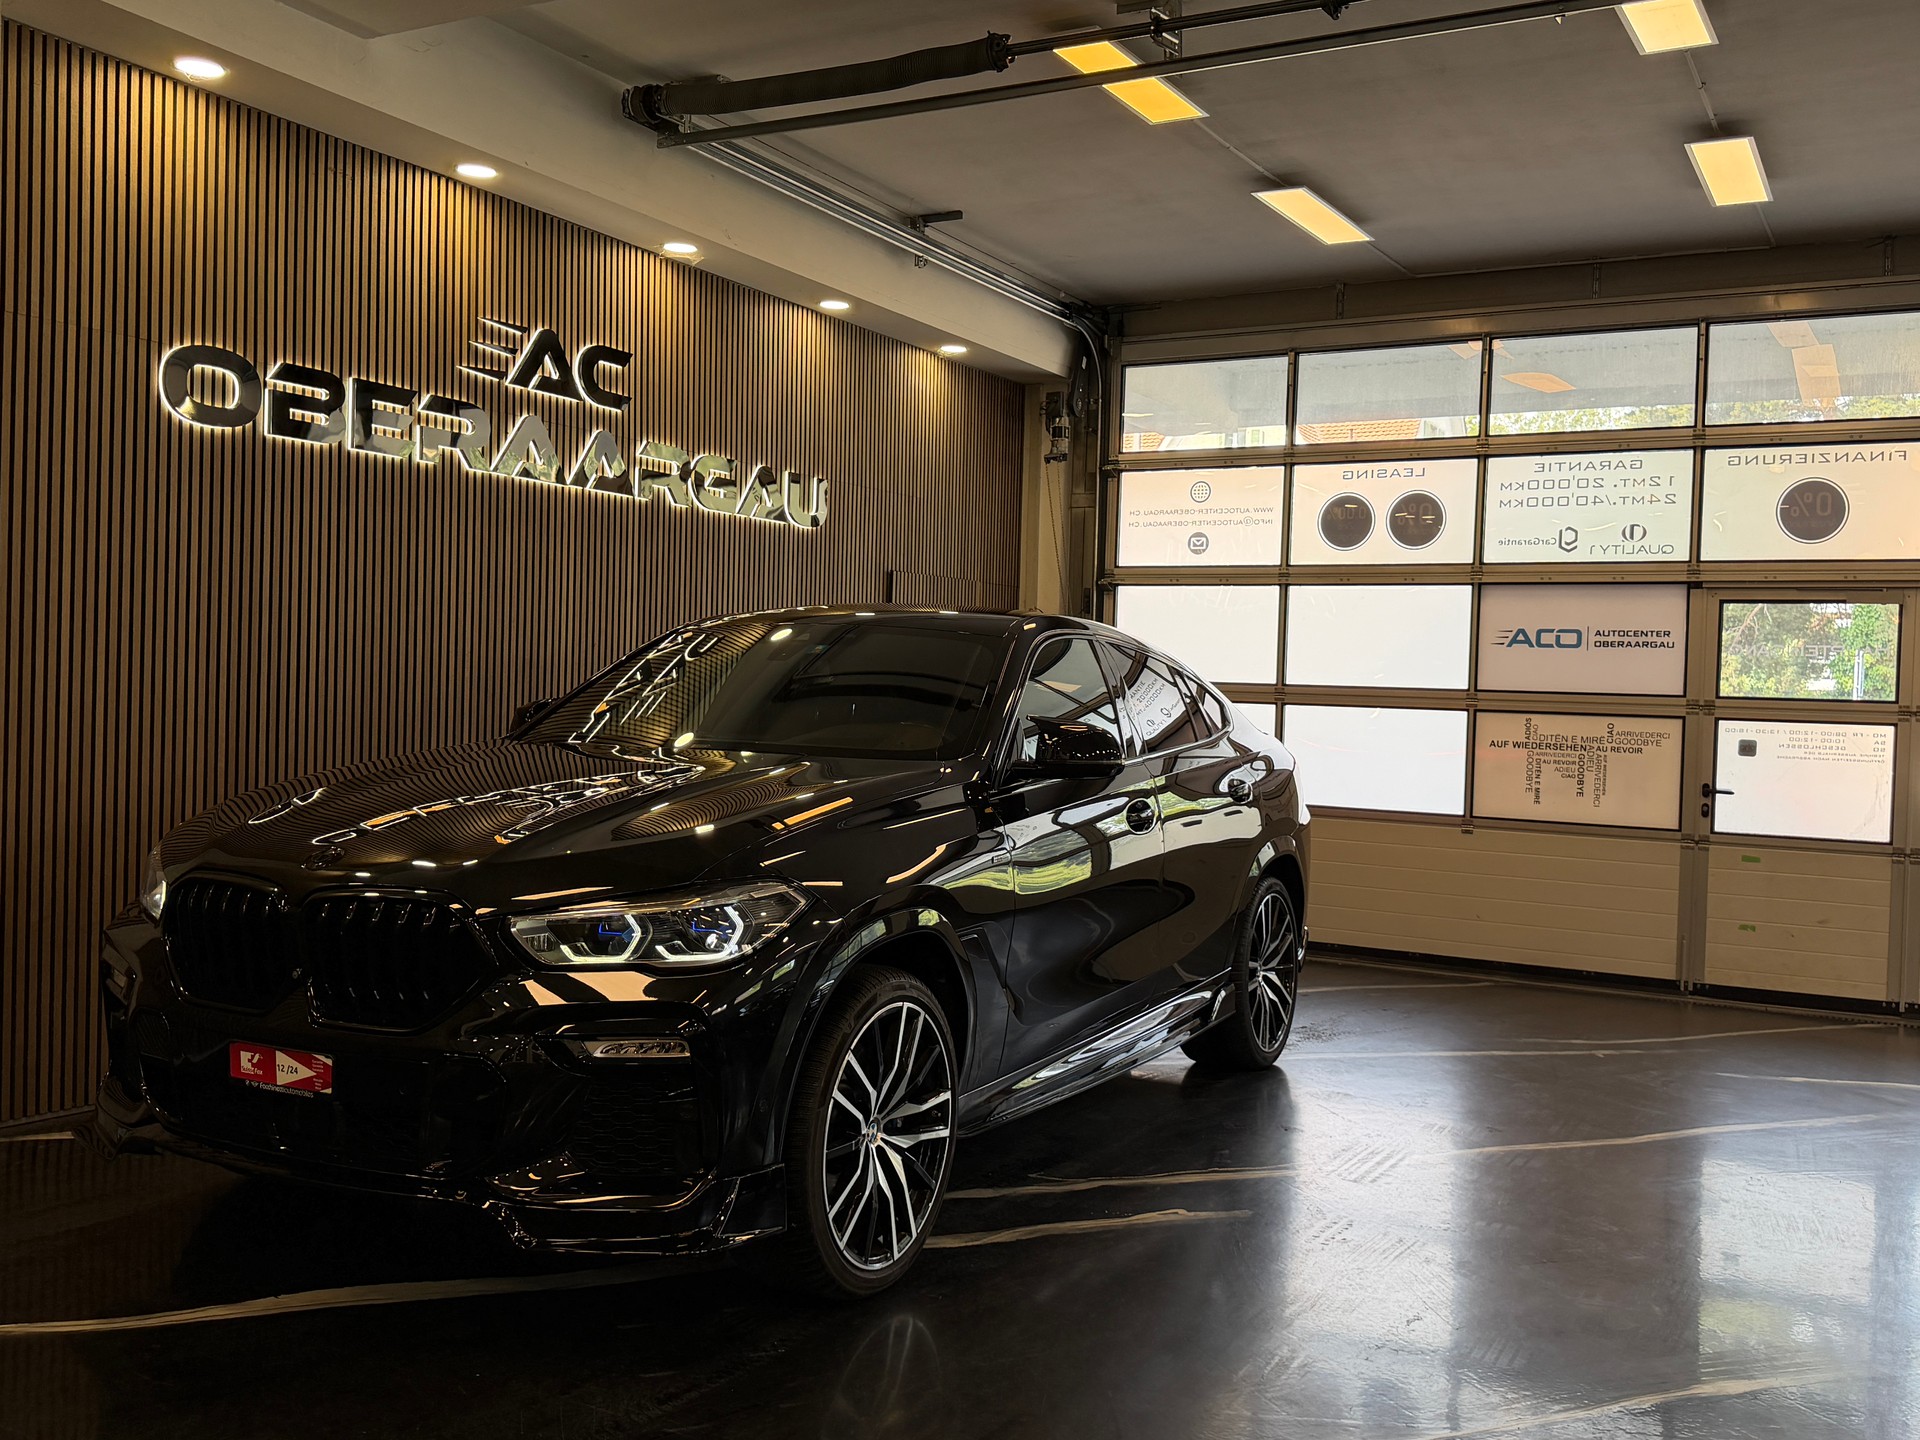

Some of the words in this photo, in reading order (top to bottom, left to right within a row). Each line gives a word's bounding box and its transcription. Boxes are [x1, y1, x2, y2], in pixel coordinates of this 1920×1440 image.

[158, 344, 830, 530] OBERAARGAU
[1506, 628, 1583, 649] ACO
[1594, 629, 1671, 638] AUTOCENTER
[1593, 640, 1675, 649] OBERAARGAU
[1571, 735, 1578, 743] E
[1606, 723, 1615, 744] CIAO
[1615, 731, 1671, 740] ARRIVEDERCI
[1489, 740, 1510, 748] AUF
[1512, 741, 1587, 752] WIEDERSEHEN
[1614, 738, 1662, 747] GOODBYE
[1535, 751, 1577, 759] ARRIVEDERCI
[1595, 745, 1608, 753] AU
[1610, 746, 1643, 754] REVOIR
[1586, 744, 1595, 772] ADIEU
[1525, 750, 1534, 793] GOODBYE
[1576, 753, 1586, 797] GOODBYE
[1593, 753, 1602, 808] ARRIVEDERCI
[277, 1063, 285, 1073] 12
